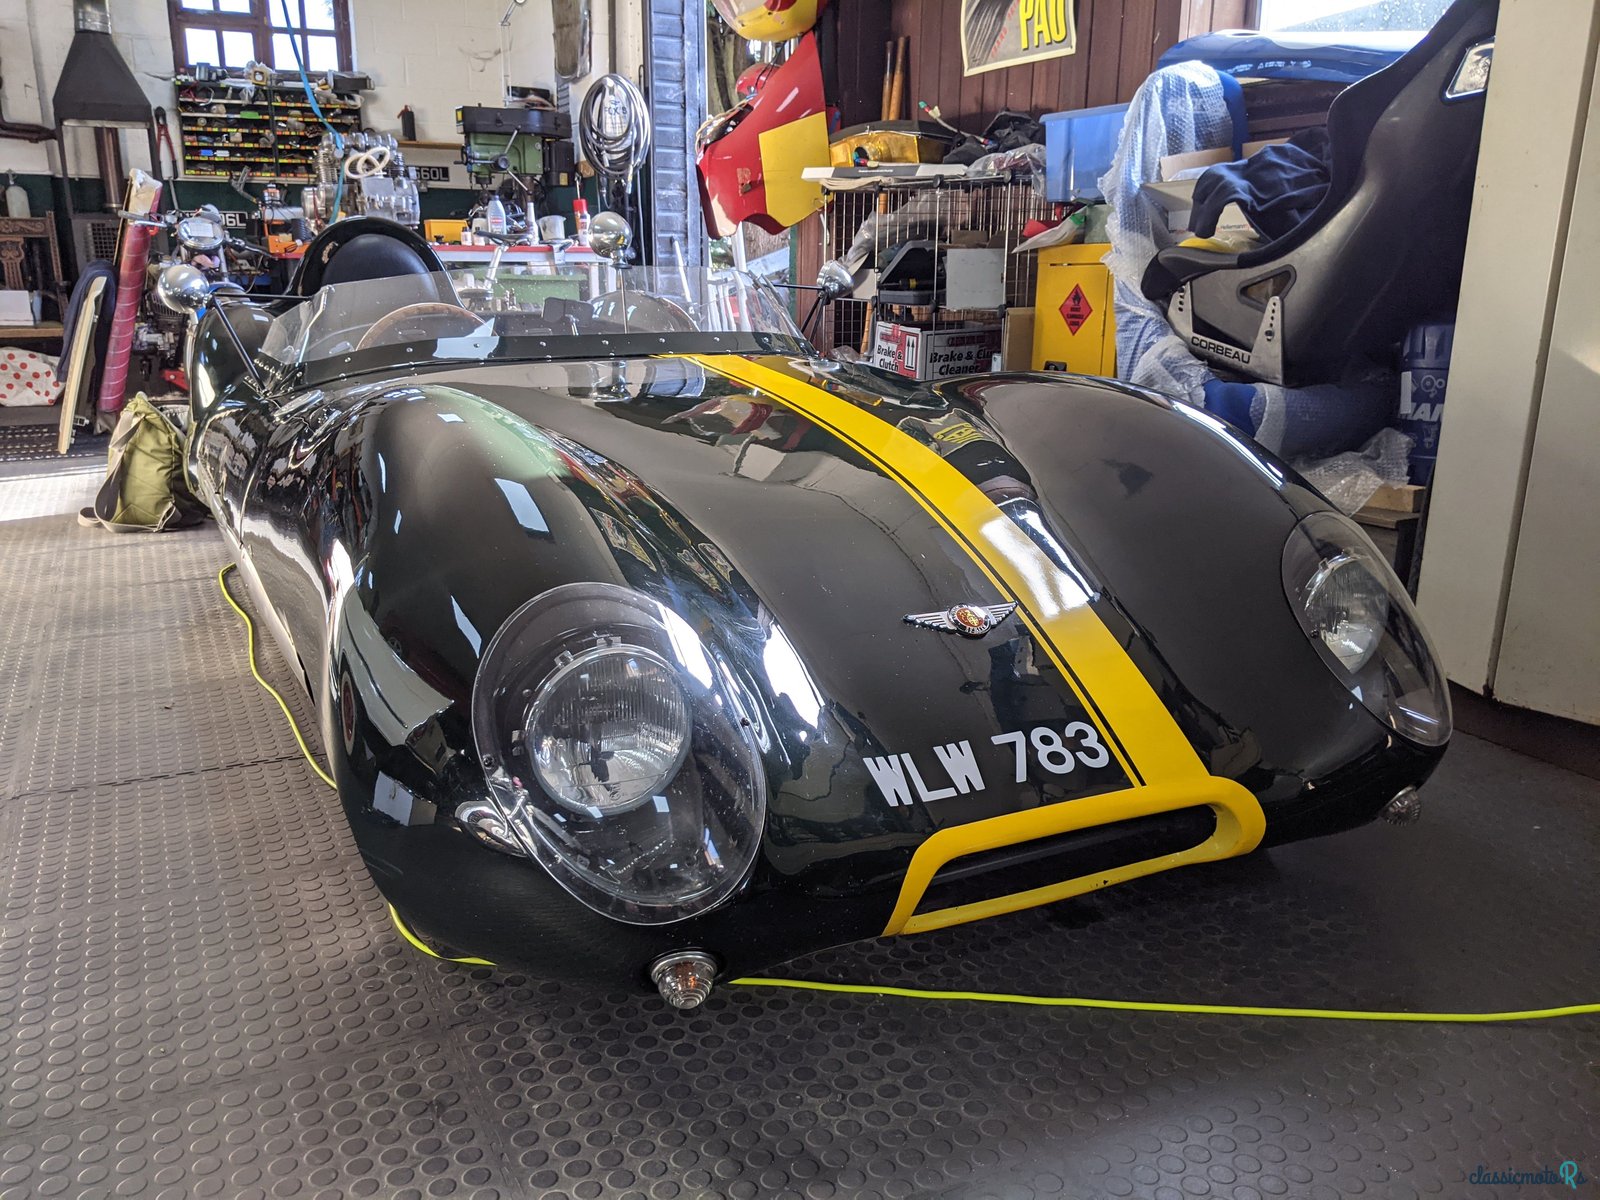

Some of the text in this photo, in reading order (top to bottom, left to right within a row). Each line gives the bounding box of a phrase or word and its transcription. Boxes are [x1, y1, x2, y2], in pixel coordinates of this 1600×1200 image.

[877, 344, 903, 360] Brake &
[930, 350, 964, 363] Brake
[965, 350, 974, 360] &
[1191, 336, 1251, 364] CORBEAU
[879, 358, 899, 372] Clutch
[938, 364, 979, 376] Cleaner
[863, 721, 1110, 807] WLW 783
